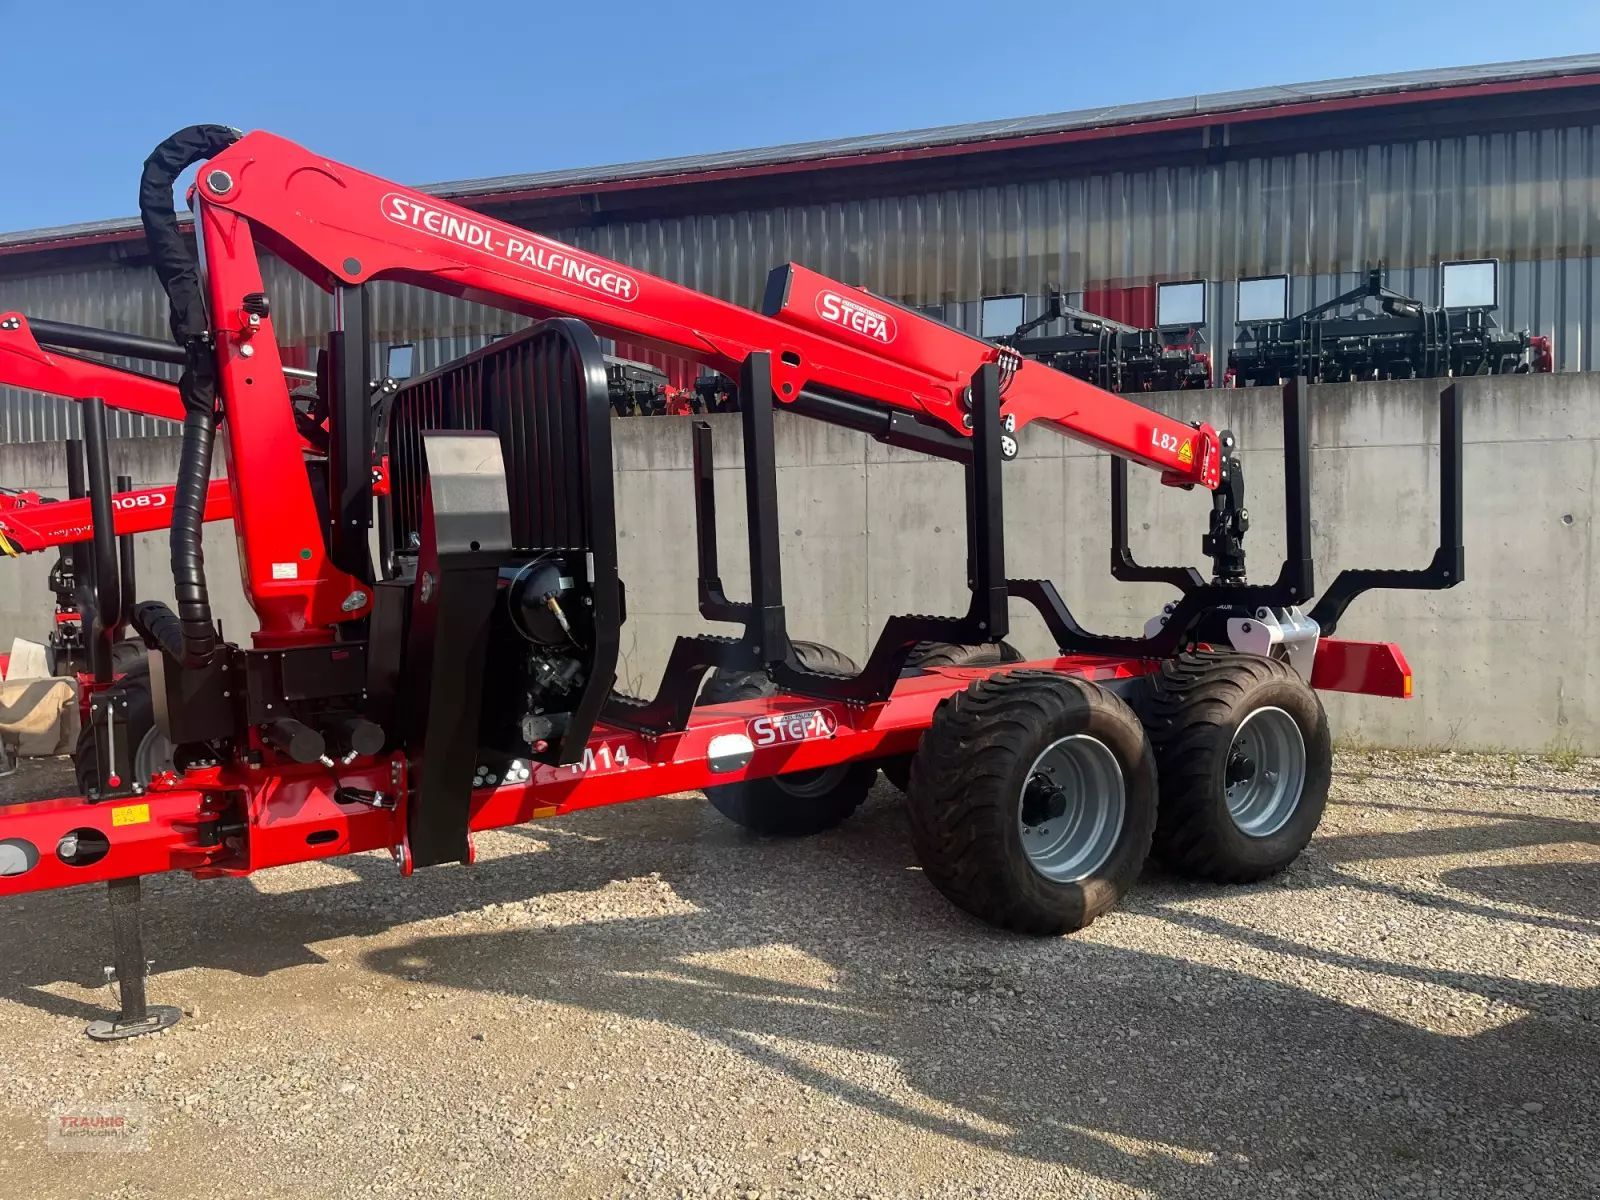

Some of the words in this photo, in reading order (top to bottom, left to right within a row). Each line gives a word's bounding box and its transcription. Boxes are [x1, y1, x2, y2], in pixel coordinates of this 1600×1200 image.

[390, 197, 632, 298] STEINDL-PALFINGER
[821, 293, 888, 341] STEPA
[1151, 427, 1178, 453] L82
[753, 714, 832, 744] STEPA
